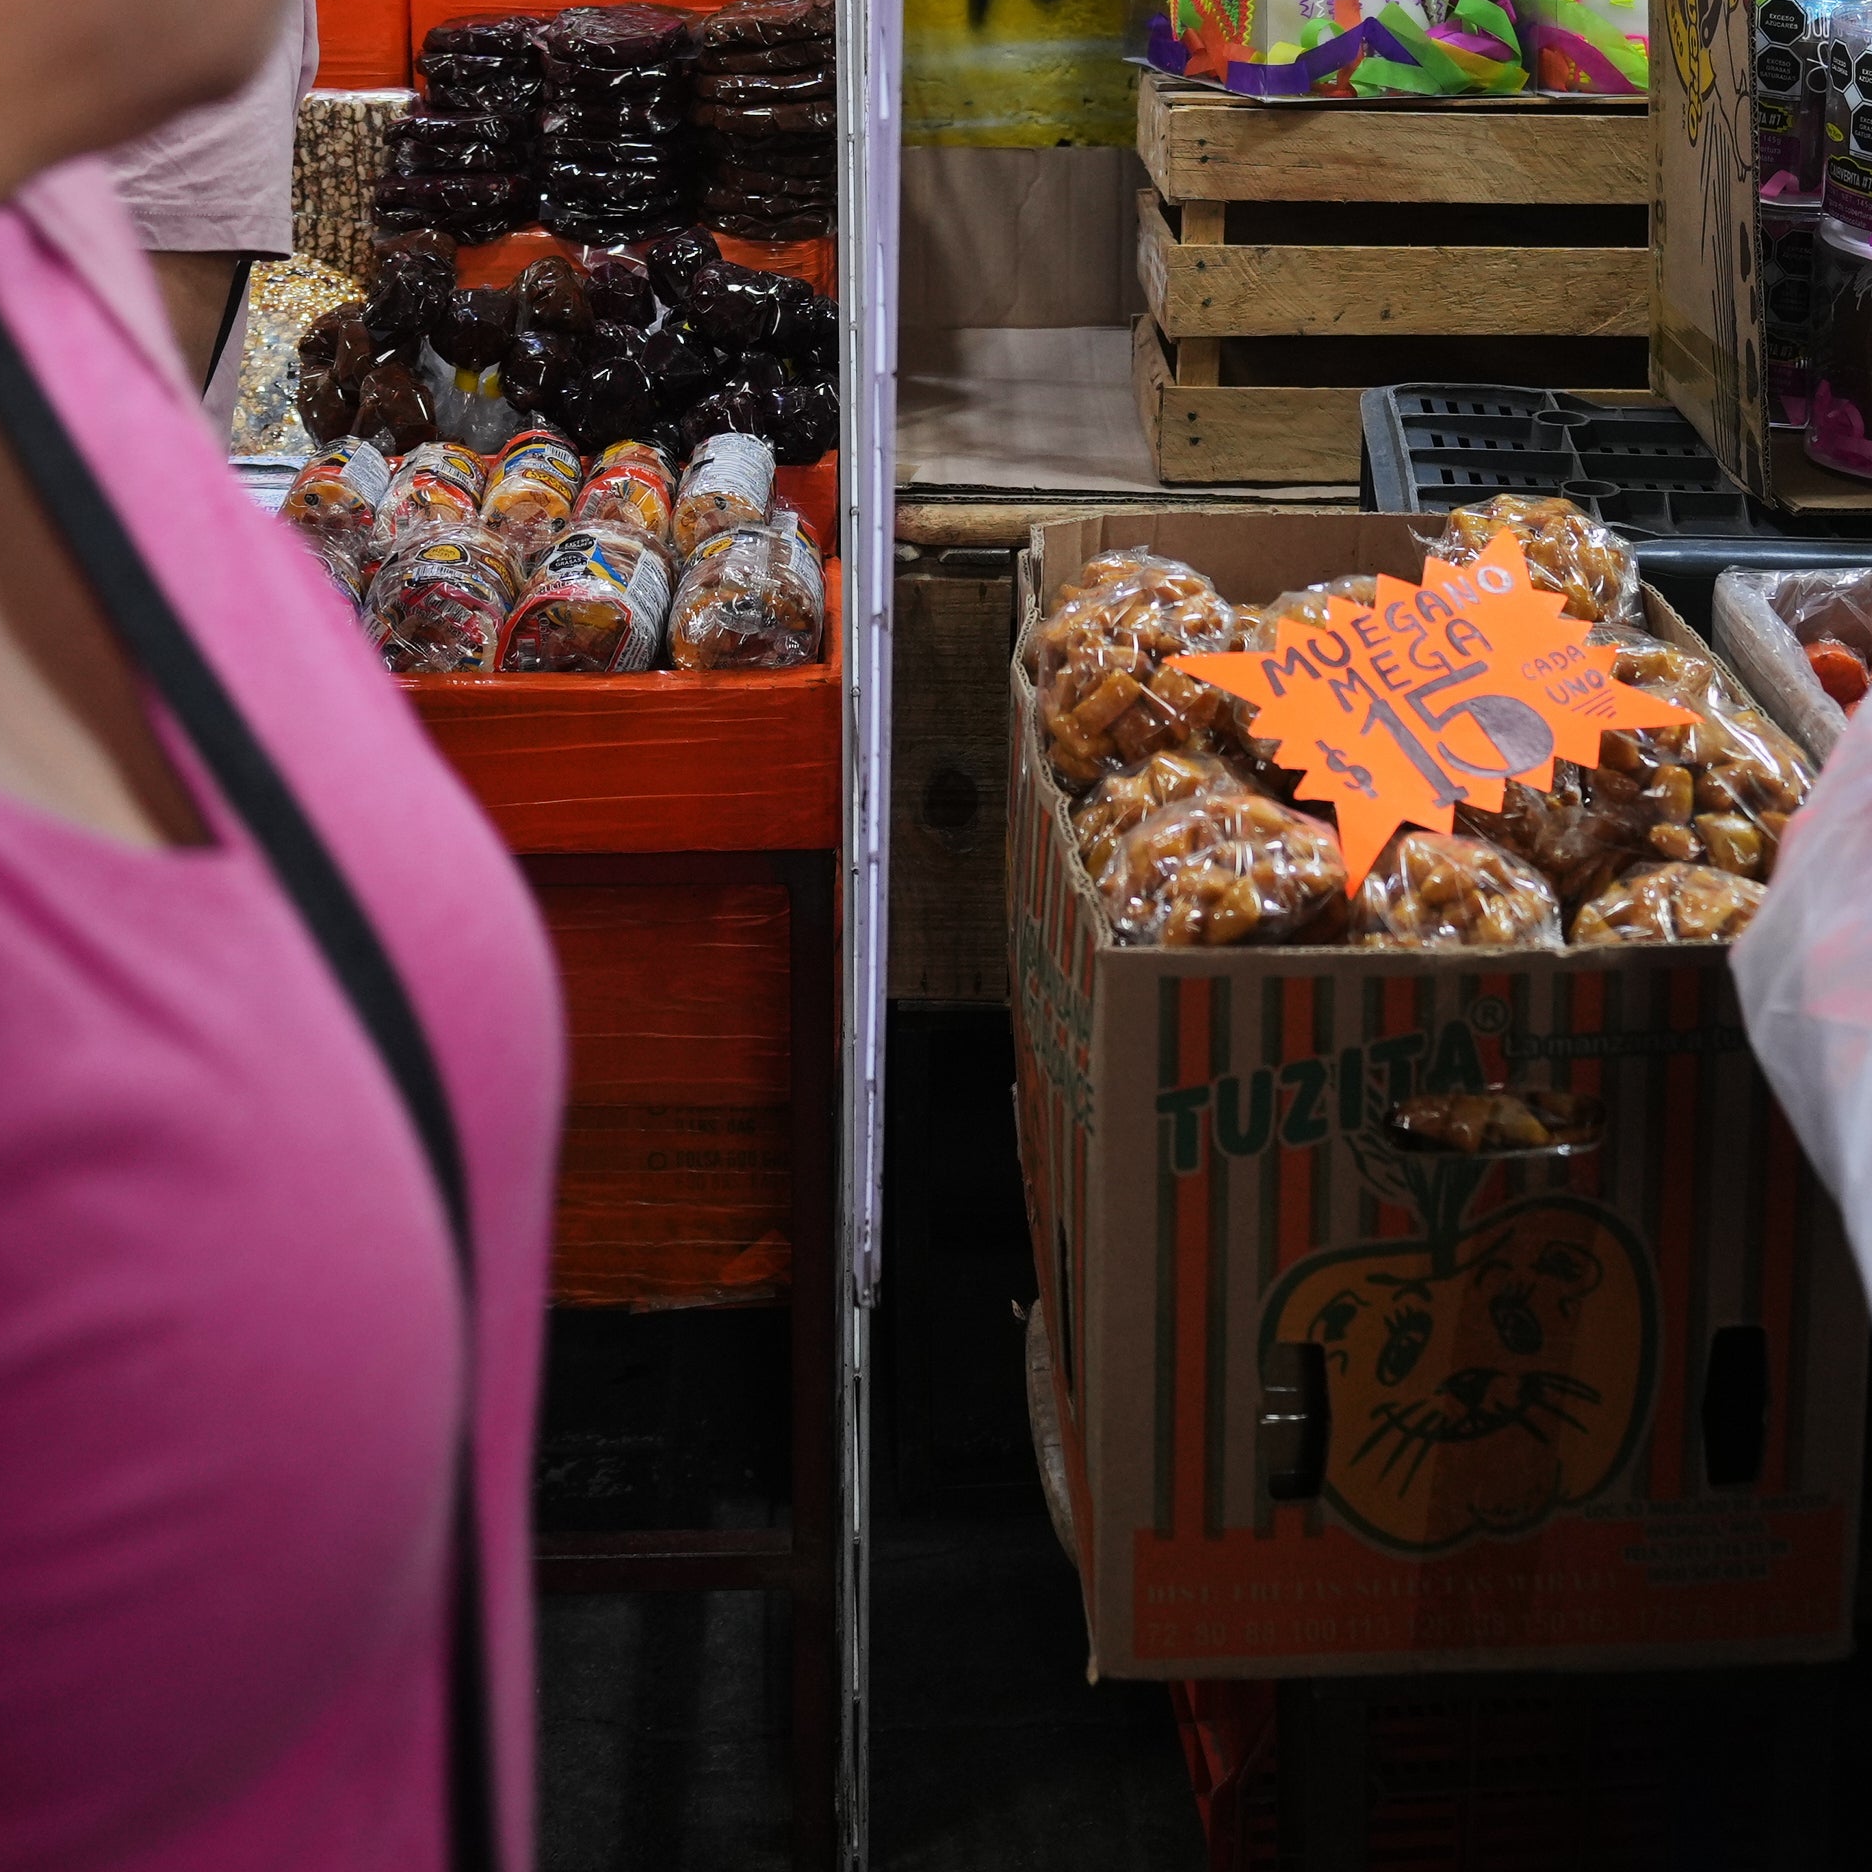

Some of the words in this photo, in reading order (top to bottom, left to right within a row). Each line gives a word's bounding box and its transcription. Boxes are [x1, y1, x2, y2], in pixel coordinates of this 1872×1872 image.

[1769, 14, 1795, 22] EXCESO
[1766, 58, 1791, 67] EXCESO
[1261, 565, 1513, 697] MUEGANO
[1328, 618, 1493, 713] MEGA
[1522, 645, 1586, 681] CADA
[1546, 669, 1605, 705] UNO
[1547, 1031, 1680, 1056] manzana
[1156, 1021, 1486, 1172] TUZITA
[1295, 1618, 1337, 1643] 100
